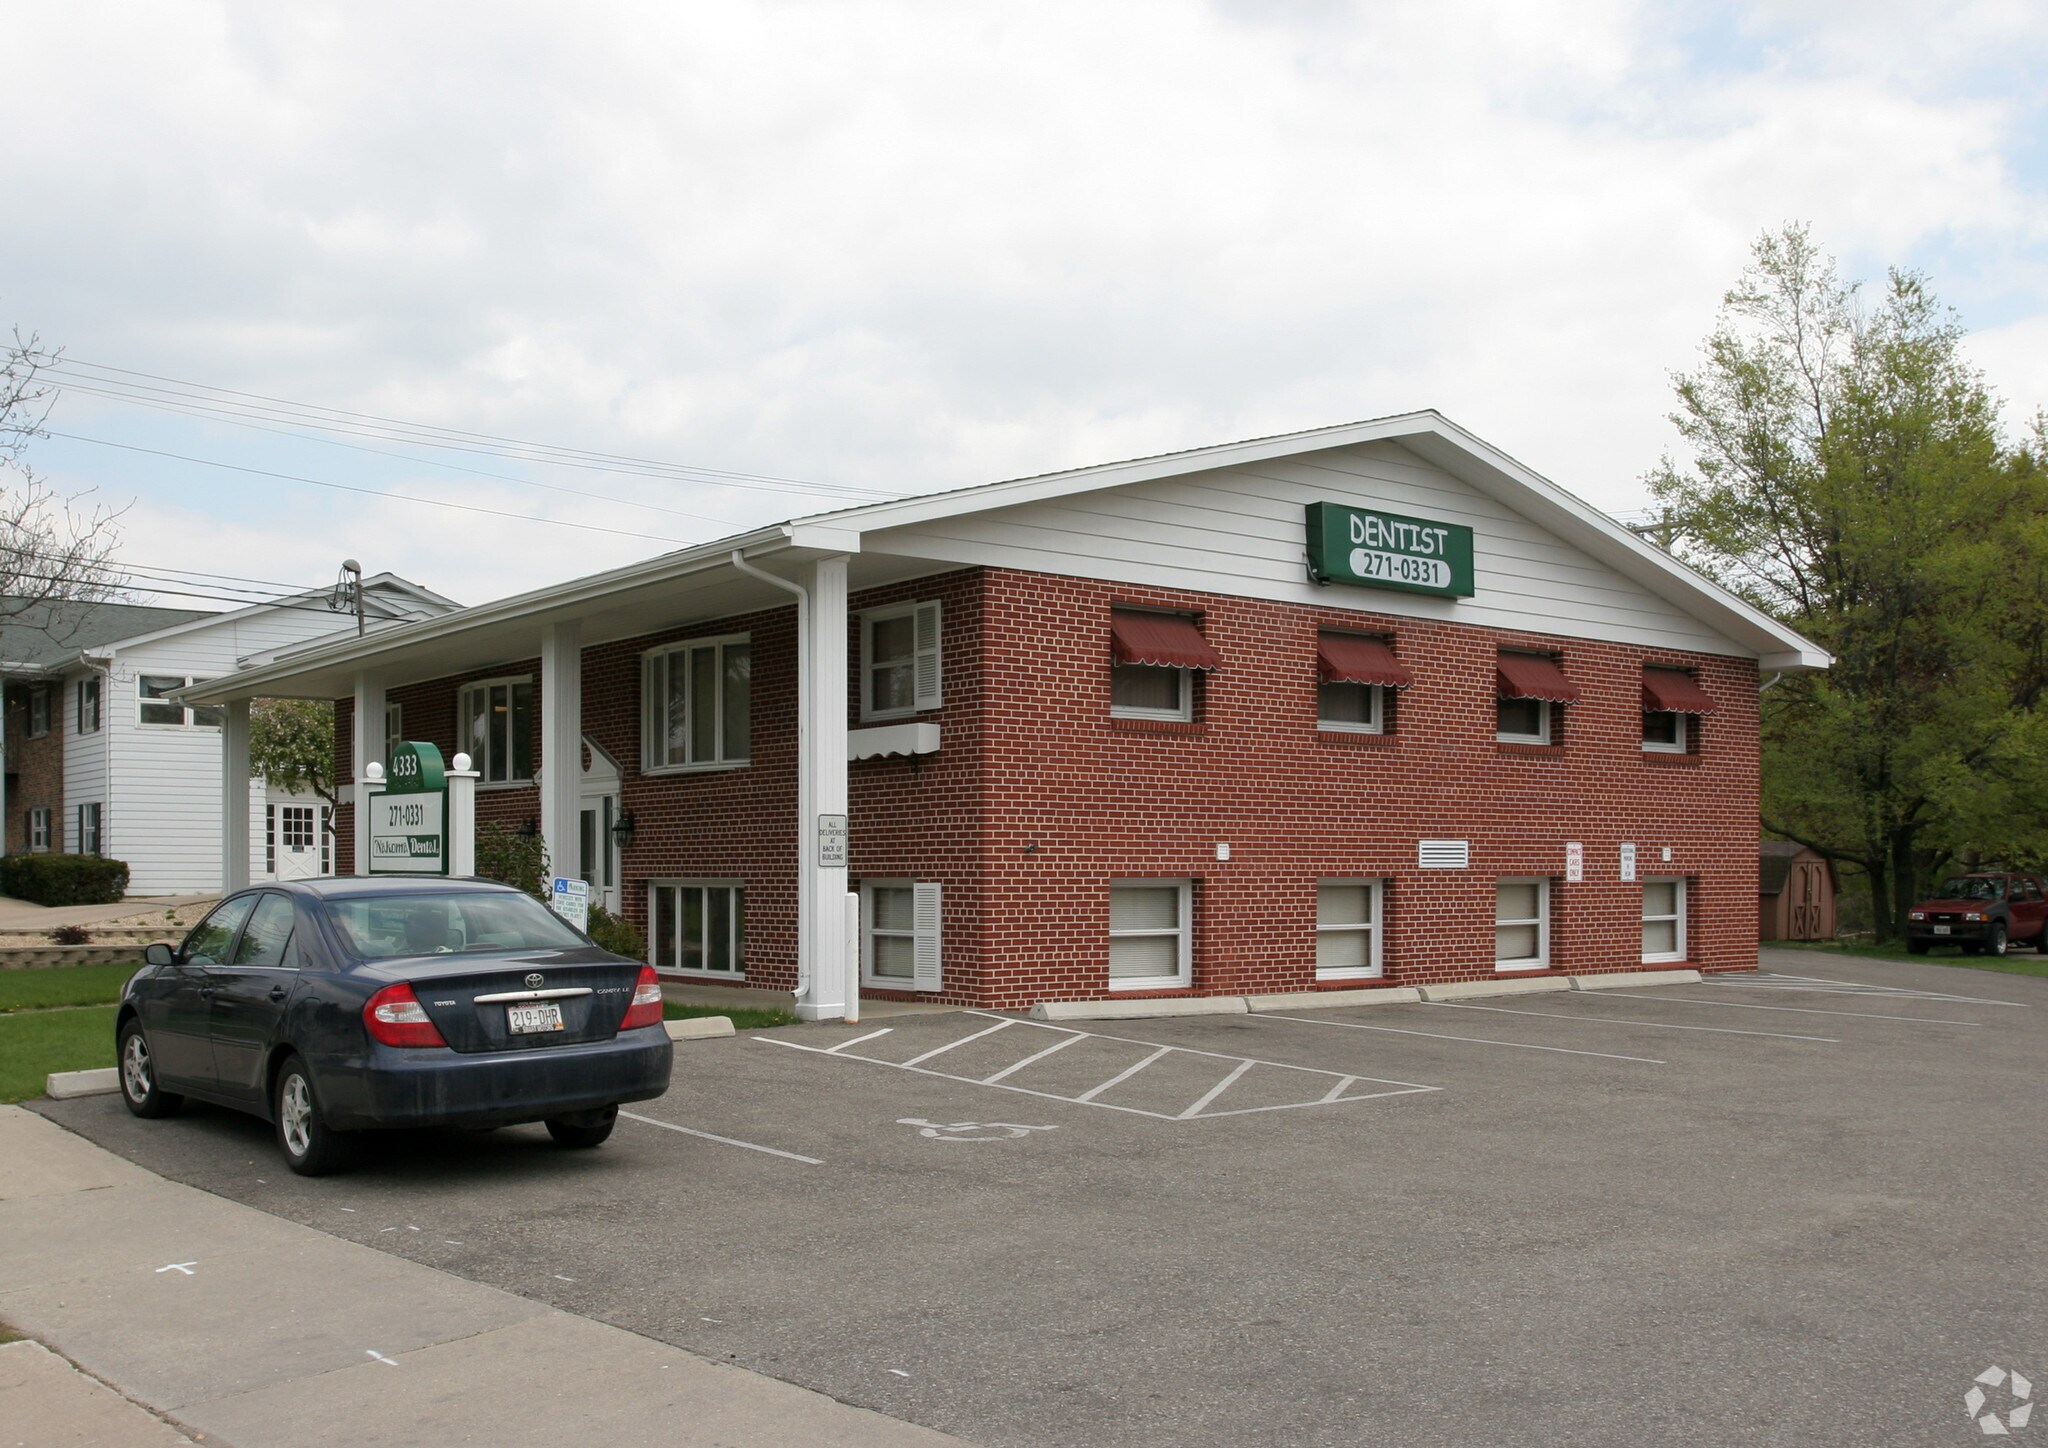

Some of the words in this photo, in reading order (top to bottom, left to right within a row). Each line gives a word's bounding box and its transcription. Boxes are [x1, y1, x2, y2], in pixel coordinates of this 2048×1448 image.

[1350, 513, 1448, 555] DENTIST
[1363, 552, 1439, 584] 271-0331
[393, 754, 417, 776] 4333
[389, 804, 424, 827] 271-0331
[512, 1008, 559, 1027] 219-DHR
